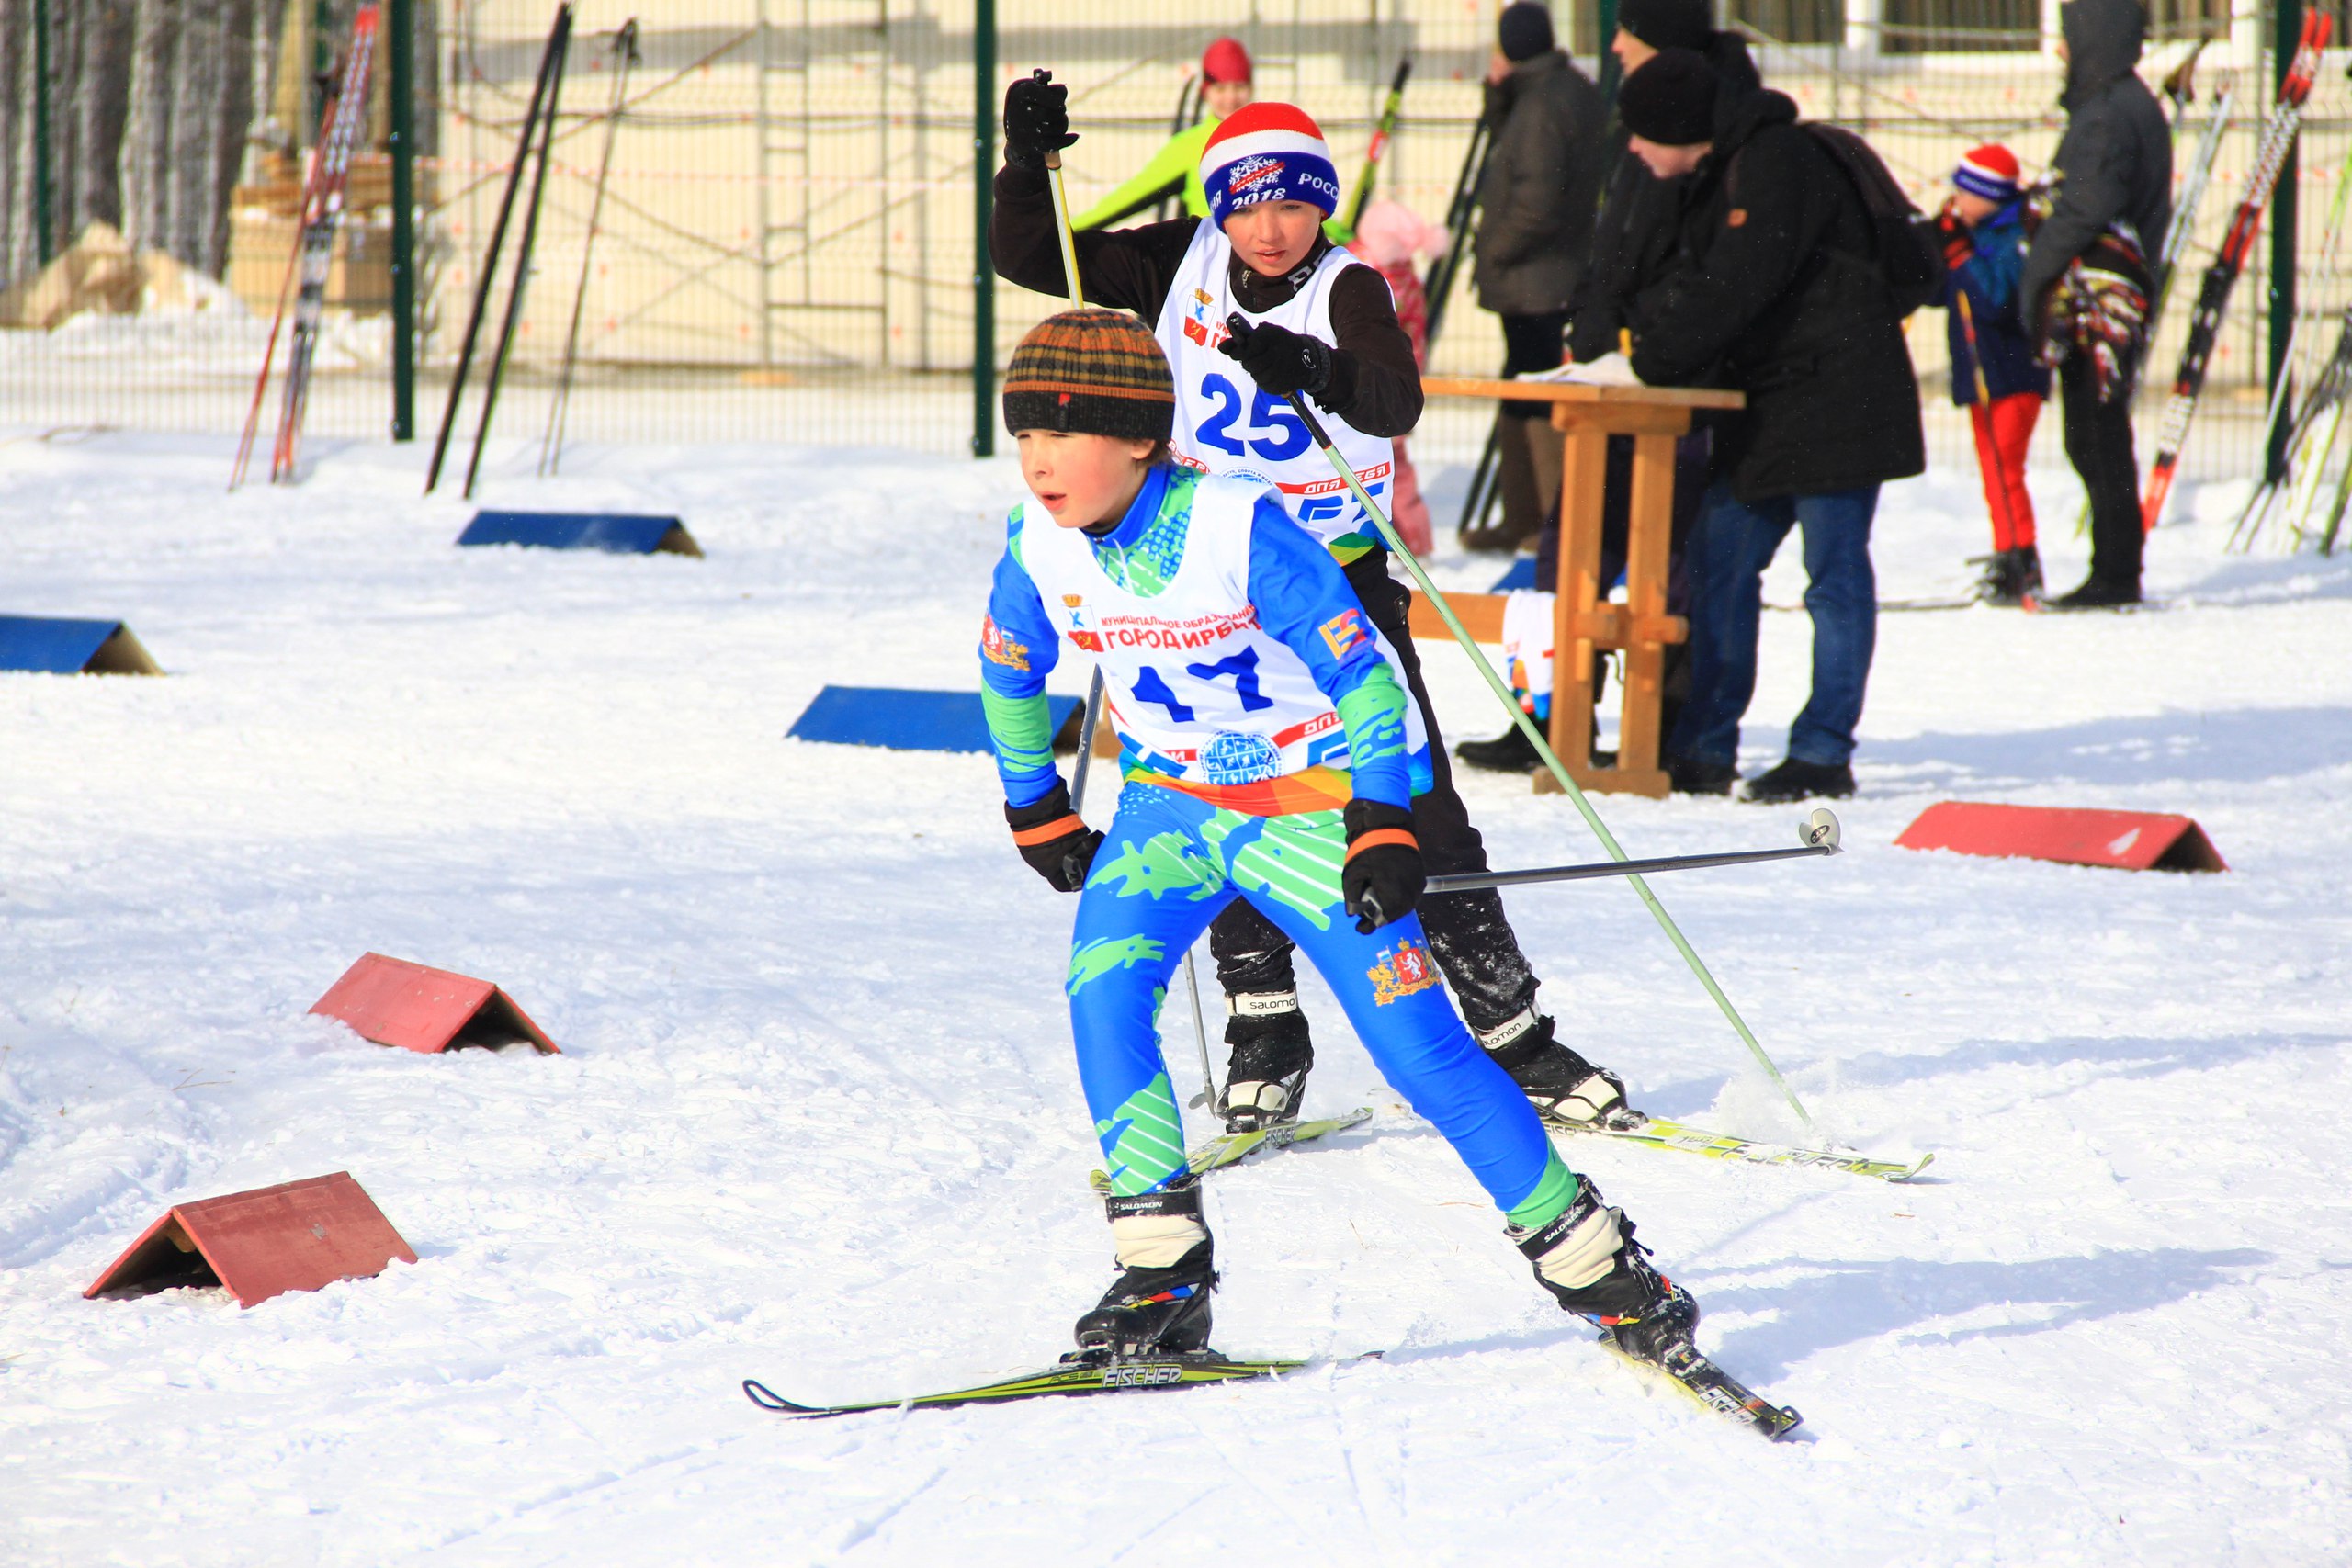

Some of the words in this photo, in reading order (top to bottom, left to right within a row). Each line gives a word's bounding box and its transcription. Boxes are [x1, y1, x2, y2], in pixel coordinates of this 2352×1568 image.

[1232, 187, 1286, 210] 2018
[1195, 373, 1313, 461] 25
[1304, 479, 1341, 494] ДЛЯ
[1354, 464, 1386, 482] ЕБЯ
[1105, 628, 1182, 650] ГОРОД
[1304, 713, 1340, 736] ДЛ
[1250, 998, 1296, 1010] salomo
[1484, 1022, 1521, 1045] lomon
[1120, 1201, 1163, 1211] SALOMON
[1102, 1367, 1182, 1387] FISCHER
